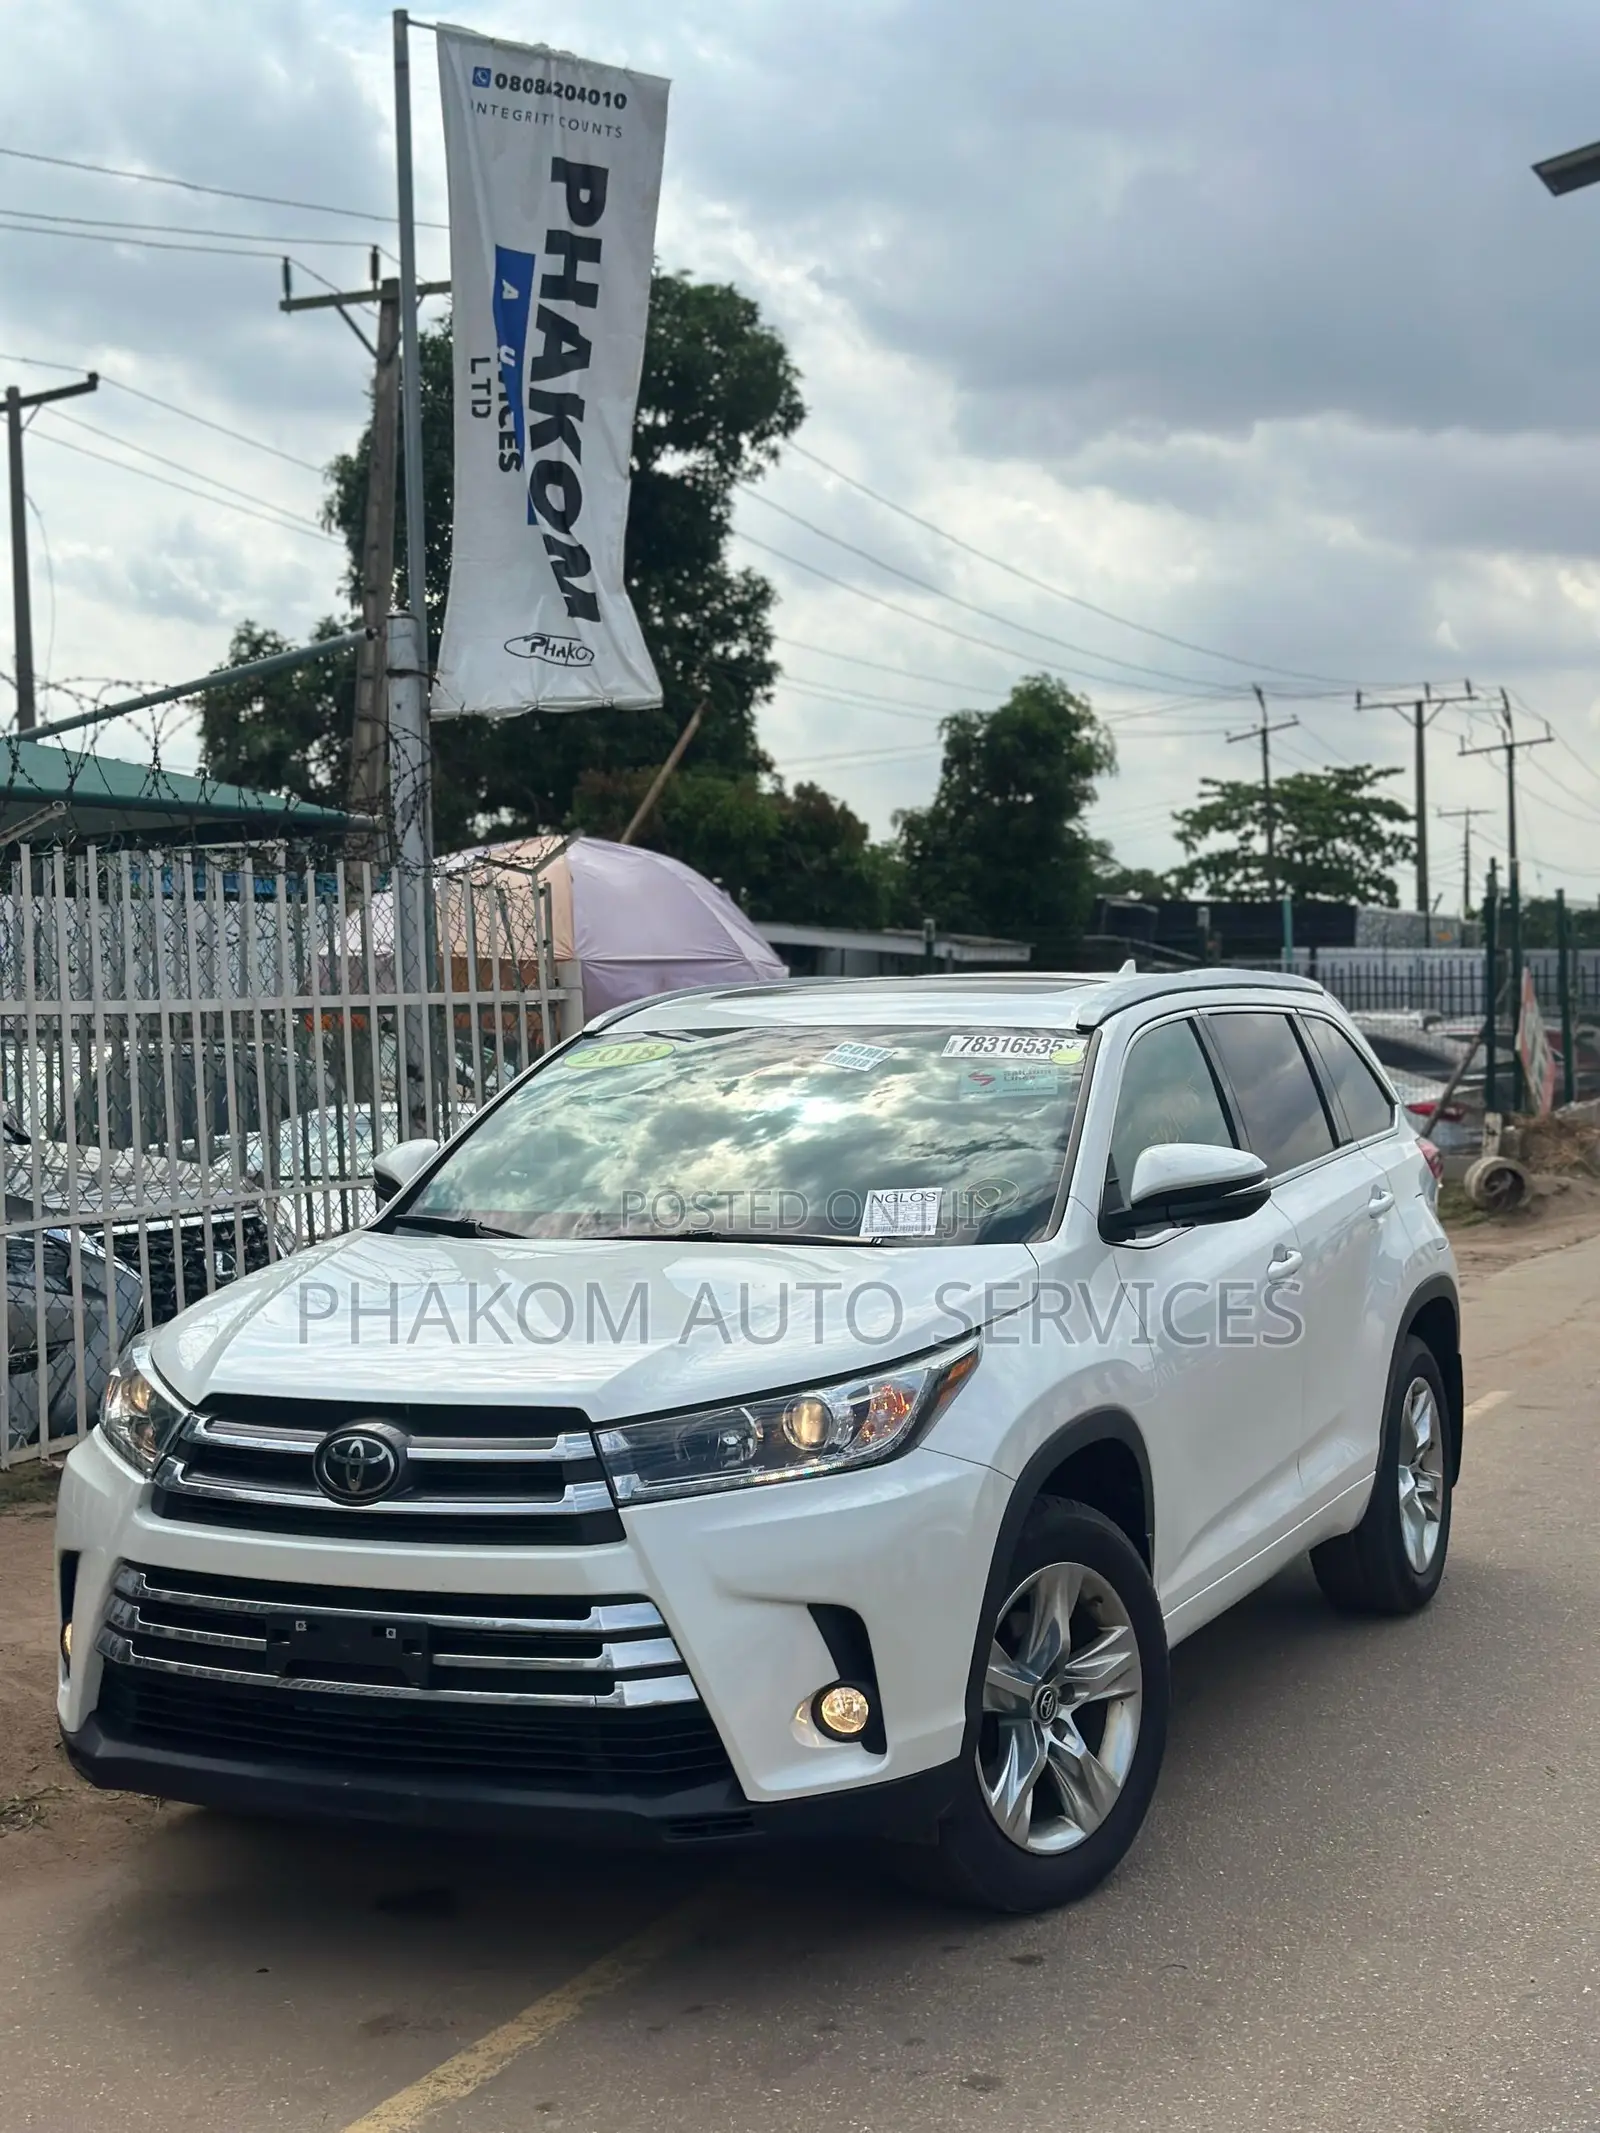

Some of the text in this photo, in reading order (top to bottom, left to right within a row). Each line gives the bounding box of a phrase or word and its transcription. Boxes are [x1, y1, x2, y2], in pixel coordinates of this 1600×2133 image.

[494, 73, 628, 110] 08084204010
[558, 115, 624, 139] COUNTS
[469, 356, 492, 419] LTD
[528, 156, 610, 623] PHAKOM
[575, 1045, 664, 1065] 2018
[958, 1035, 1065, 1055] 78316535
[871, 1192, 937, 1204] NGLOS
